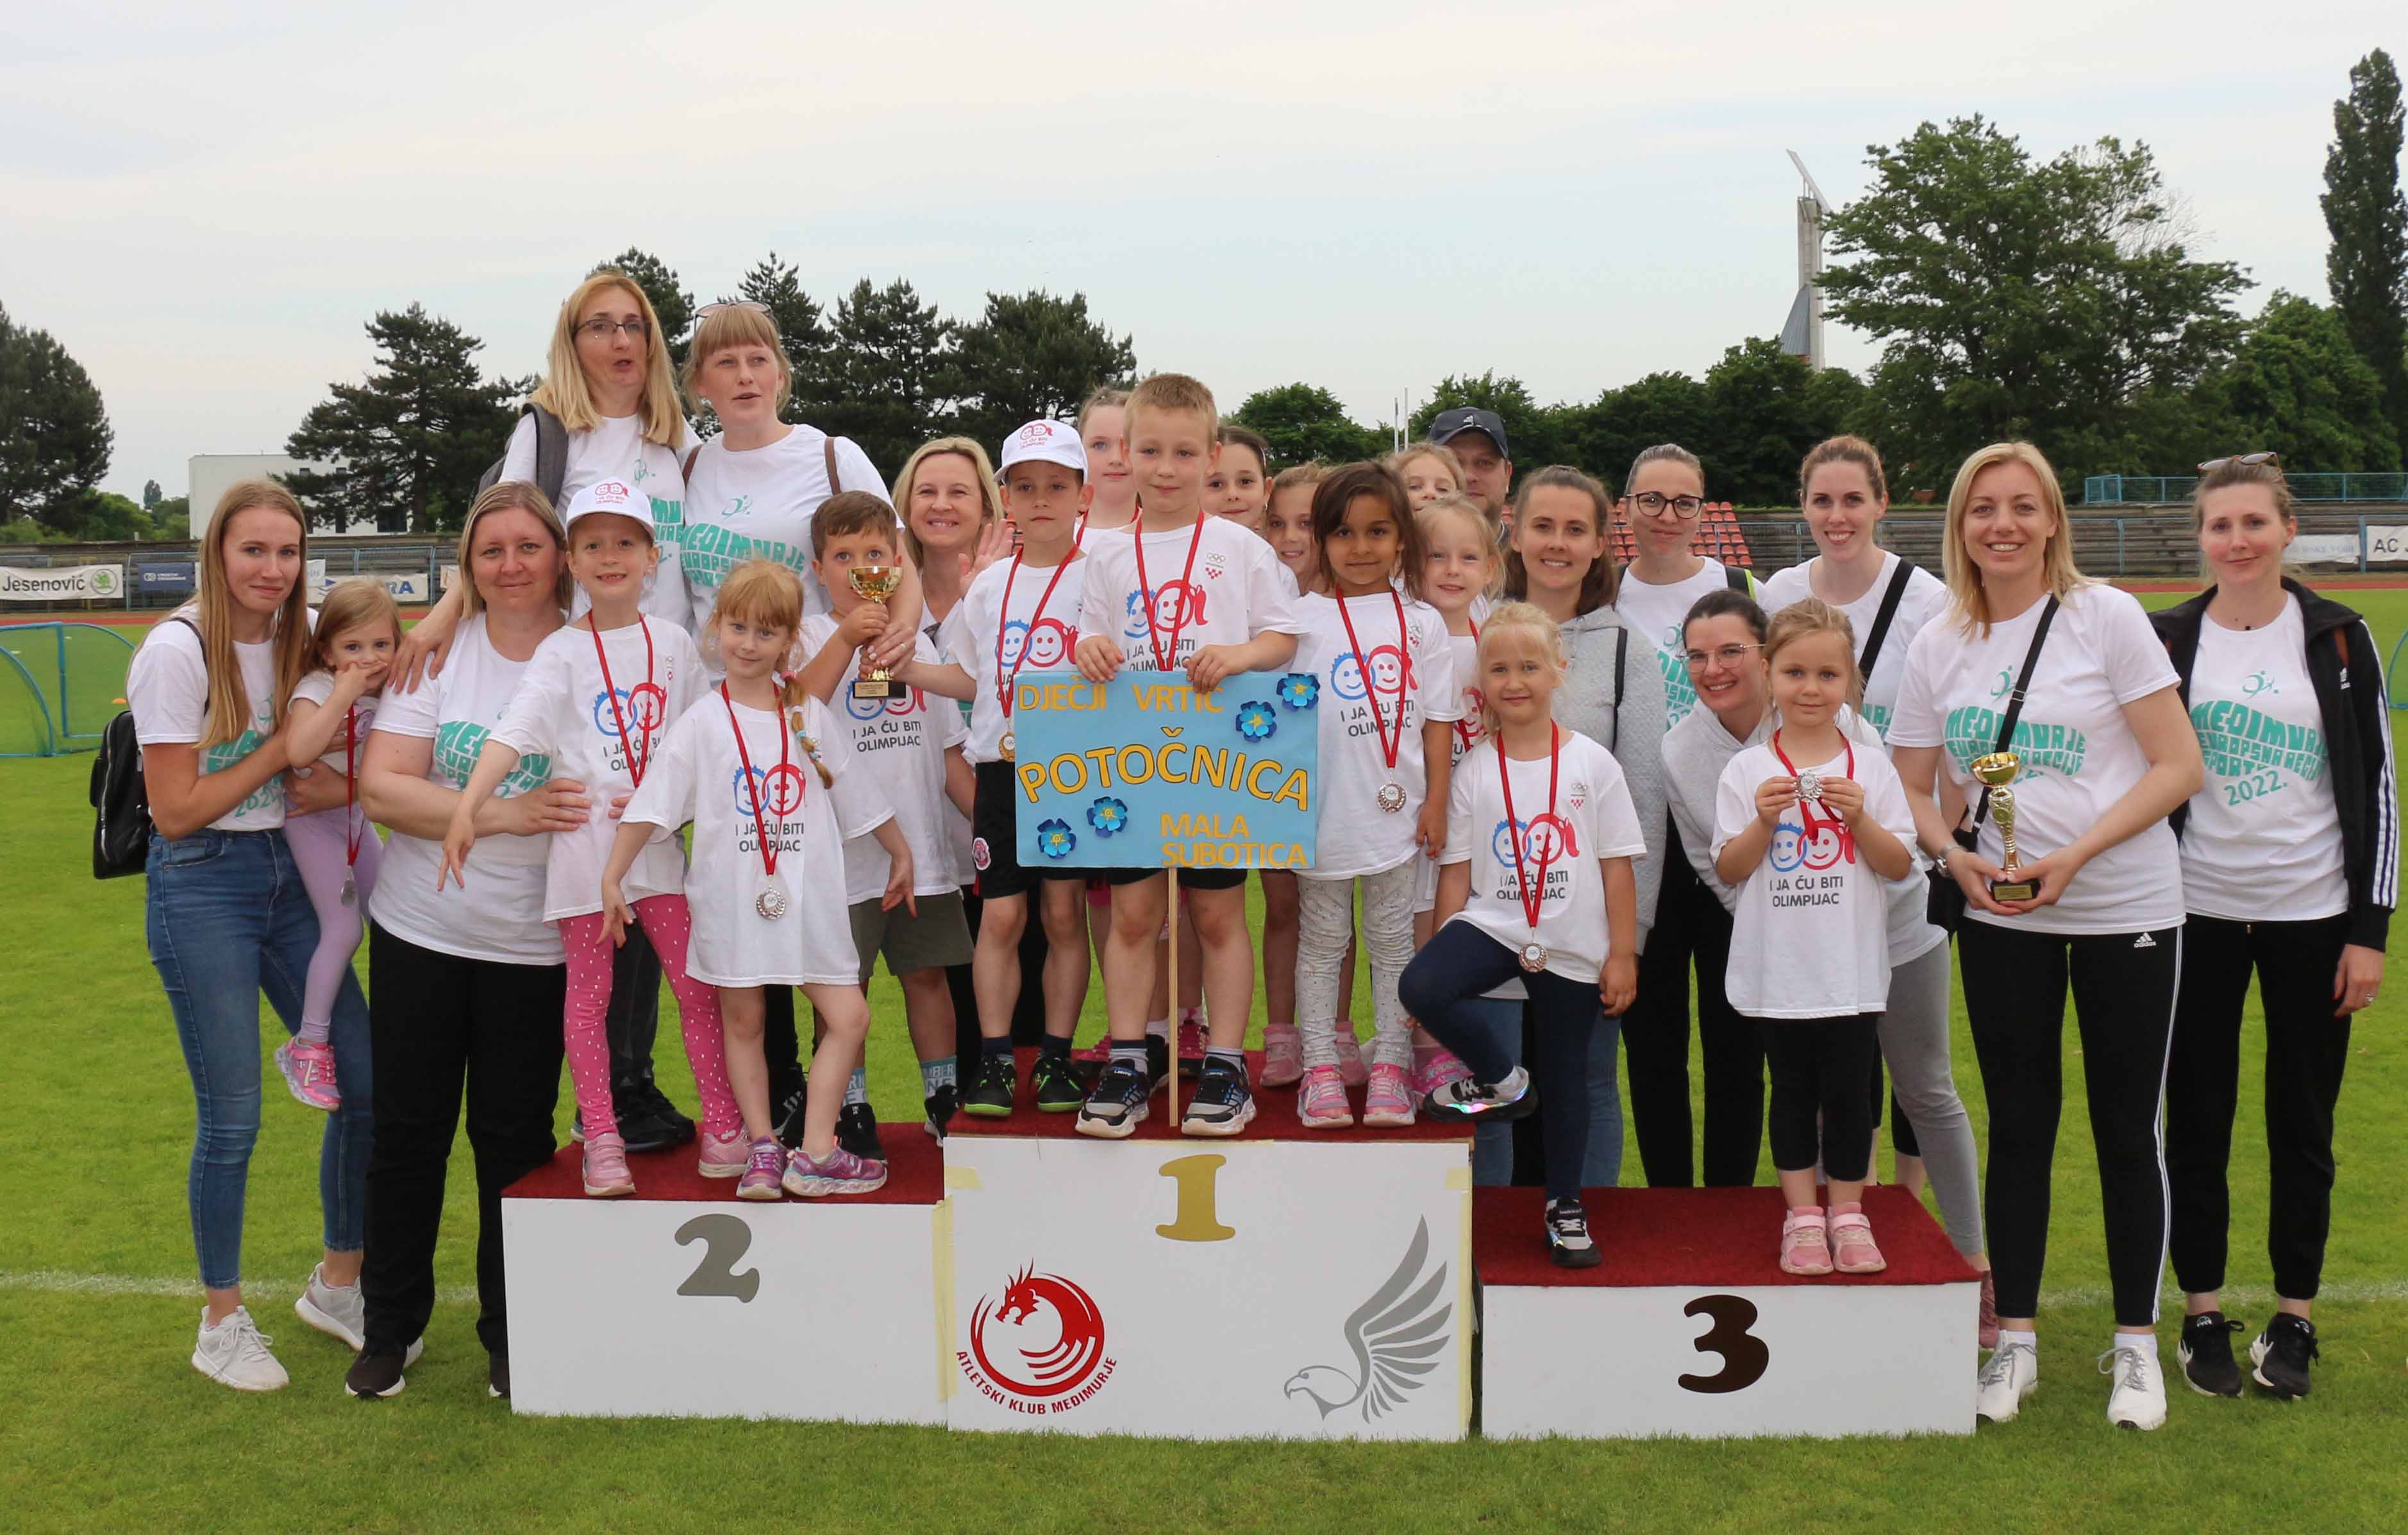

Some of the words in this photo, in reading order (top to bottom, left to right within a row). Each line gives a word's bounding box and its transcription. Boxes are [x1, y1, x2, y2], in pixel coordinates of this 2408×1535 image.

[2373, 538, 2398, 553] AC
[3, 574, 85, 592] Jesenović
[1133, 644, 1144, 657] JA
[1018, 675, 1107, 711] DJEČJI
[1351, 706, 1367, 719] JA
[1395, 700, 1414, 712] BTI
[853, 729, 856, 739] I
[862, 726, 876, 737] JA
[881, 720, 898, 733] ĆU
[903, 721, 921, 731] BITI
[857, 735, 921, 752] OLIMPIJAC
[1017, 726, 1308, 812] POTOČNICA
[744, 823, 758, 835] JA
[783, 823, 804, 835] BITI
[1160, 812, 1250, 839] MALA
[739, 839, 801, 852] OLIPJAC
[1161, 841, 1309, 868] SUBOTICA
[1547, 870, 1568, 884] BITI
[1769, 879, 1773, 891] I
[1777, 878, 1790, 891] JA
[1795, 875, 1815, 891] ĆU
[1821, 876, 1843, 888] BITI
[1496, 887, 1566, 901] OLIPJAC
[1772, 893, 1839, 907] OLIMPIJAC
[1156, 1154, 1235, 1242] 1
[674, 1214, 760, 1303] 2
[1678, 1294, 1769, 1394] 3
[956, 1351, 1005, 1404] ATLETSKI
[1008, 1398, 1046, 1414] KLUB
